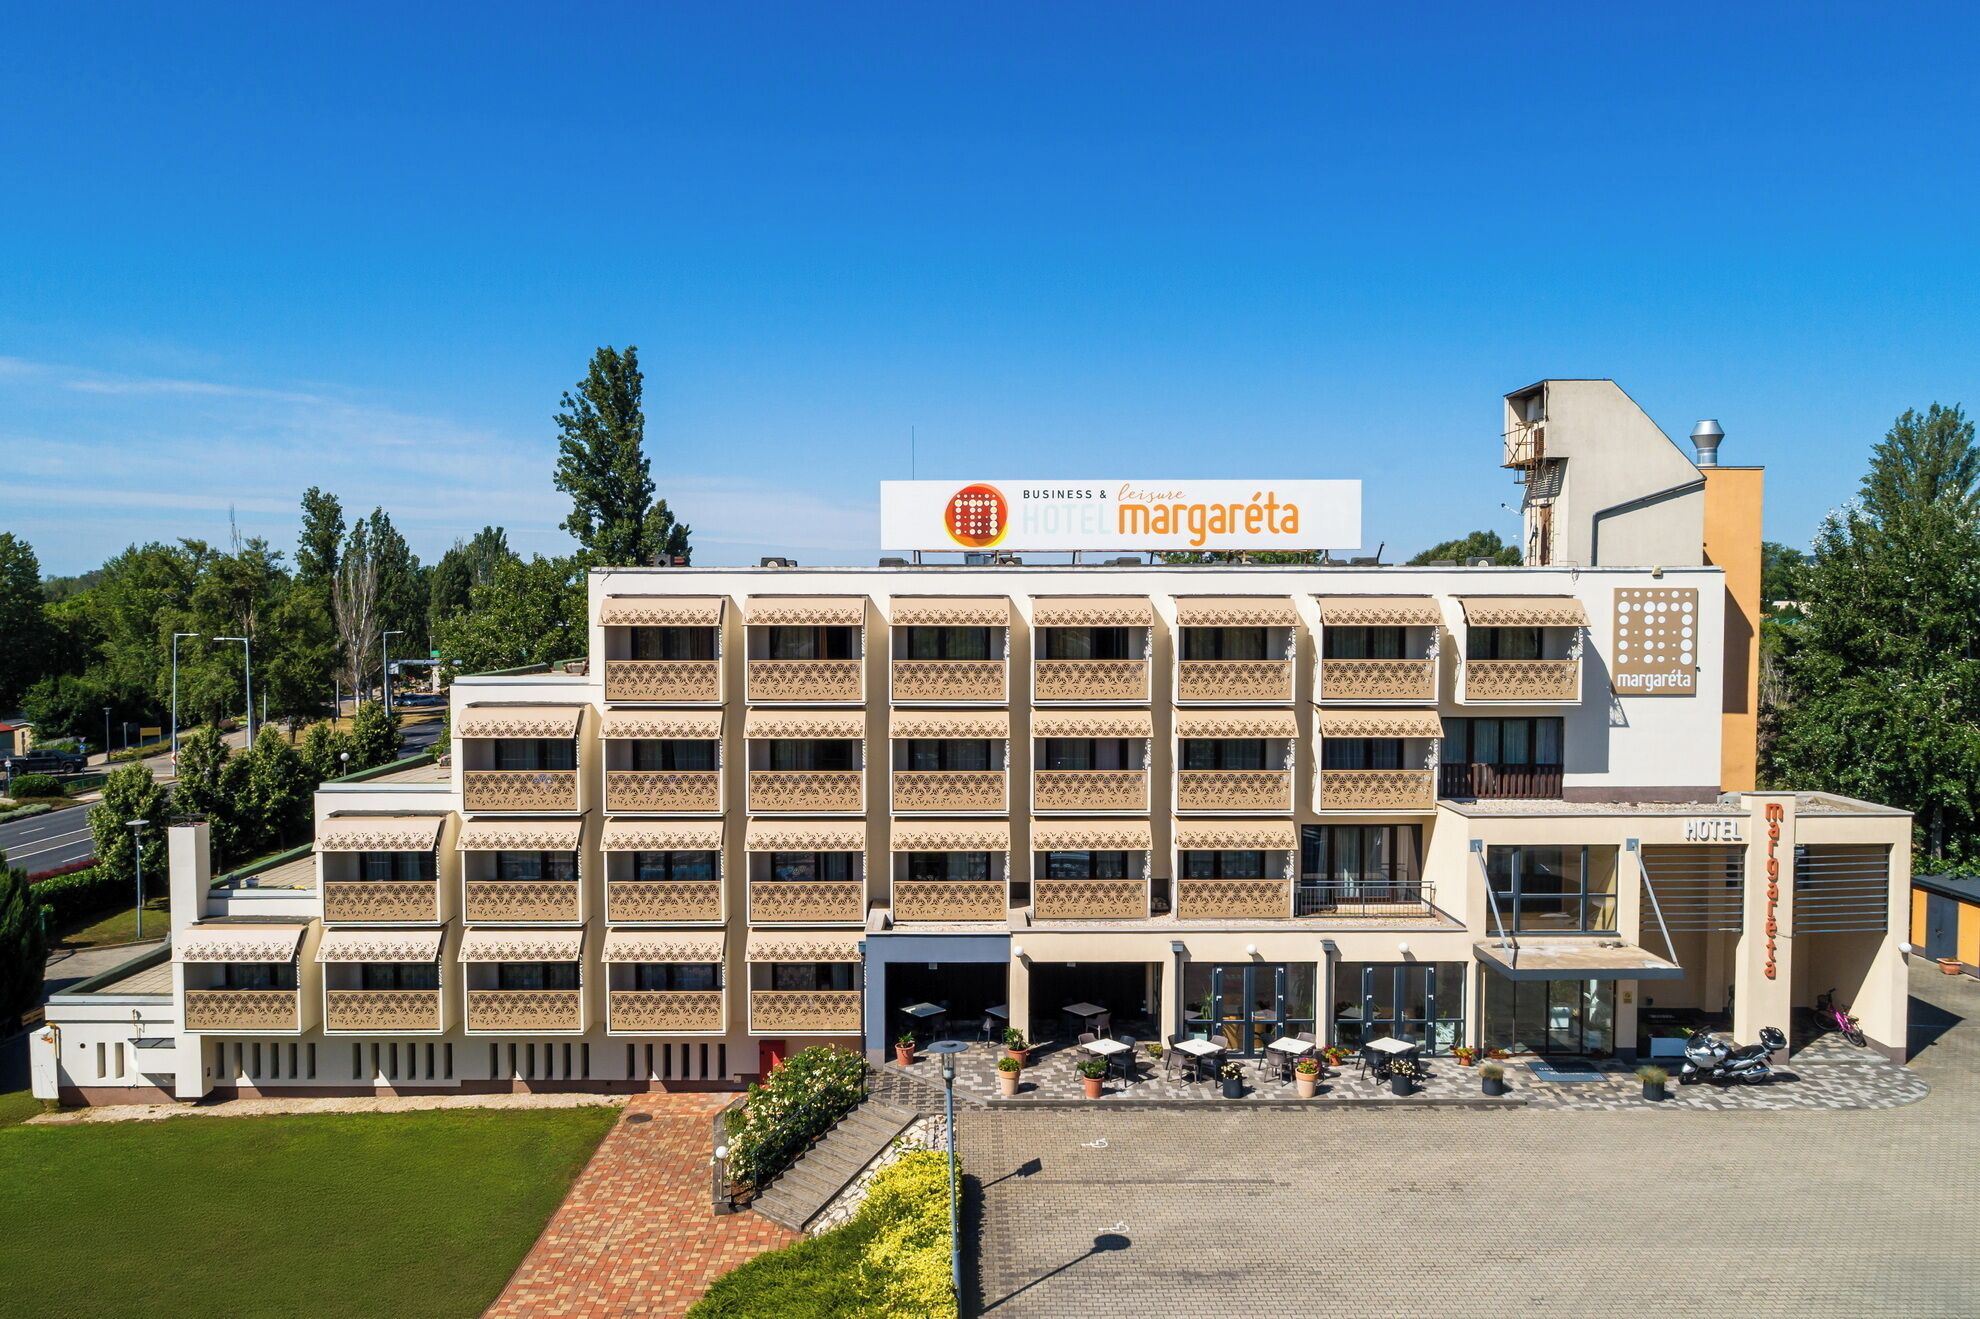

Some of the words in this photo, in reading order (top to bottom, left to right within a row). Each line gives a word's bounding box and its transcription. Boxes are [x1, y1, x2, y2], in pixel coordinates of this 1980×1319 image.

[1023, 489, 1092, 499] BUSINESS
[1099, 489, 1107, 499] &
[1117, 482, 1187, 504] leisure
[1022, 503, 1113, 534] HOTEL
[1118, 490, 1299, 547] margaréta
[1616, 669, 1692, 692] margaréta
[1684, 819, 1743, 842] HOTEL
